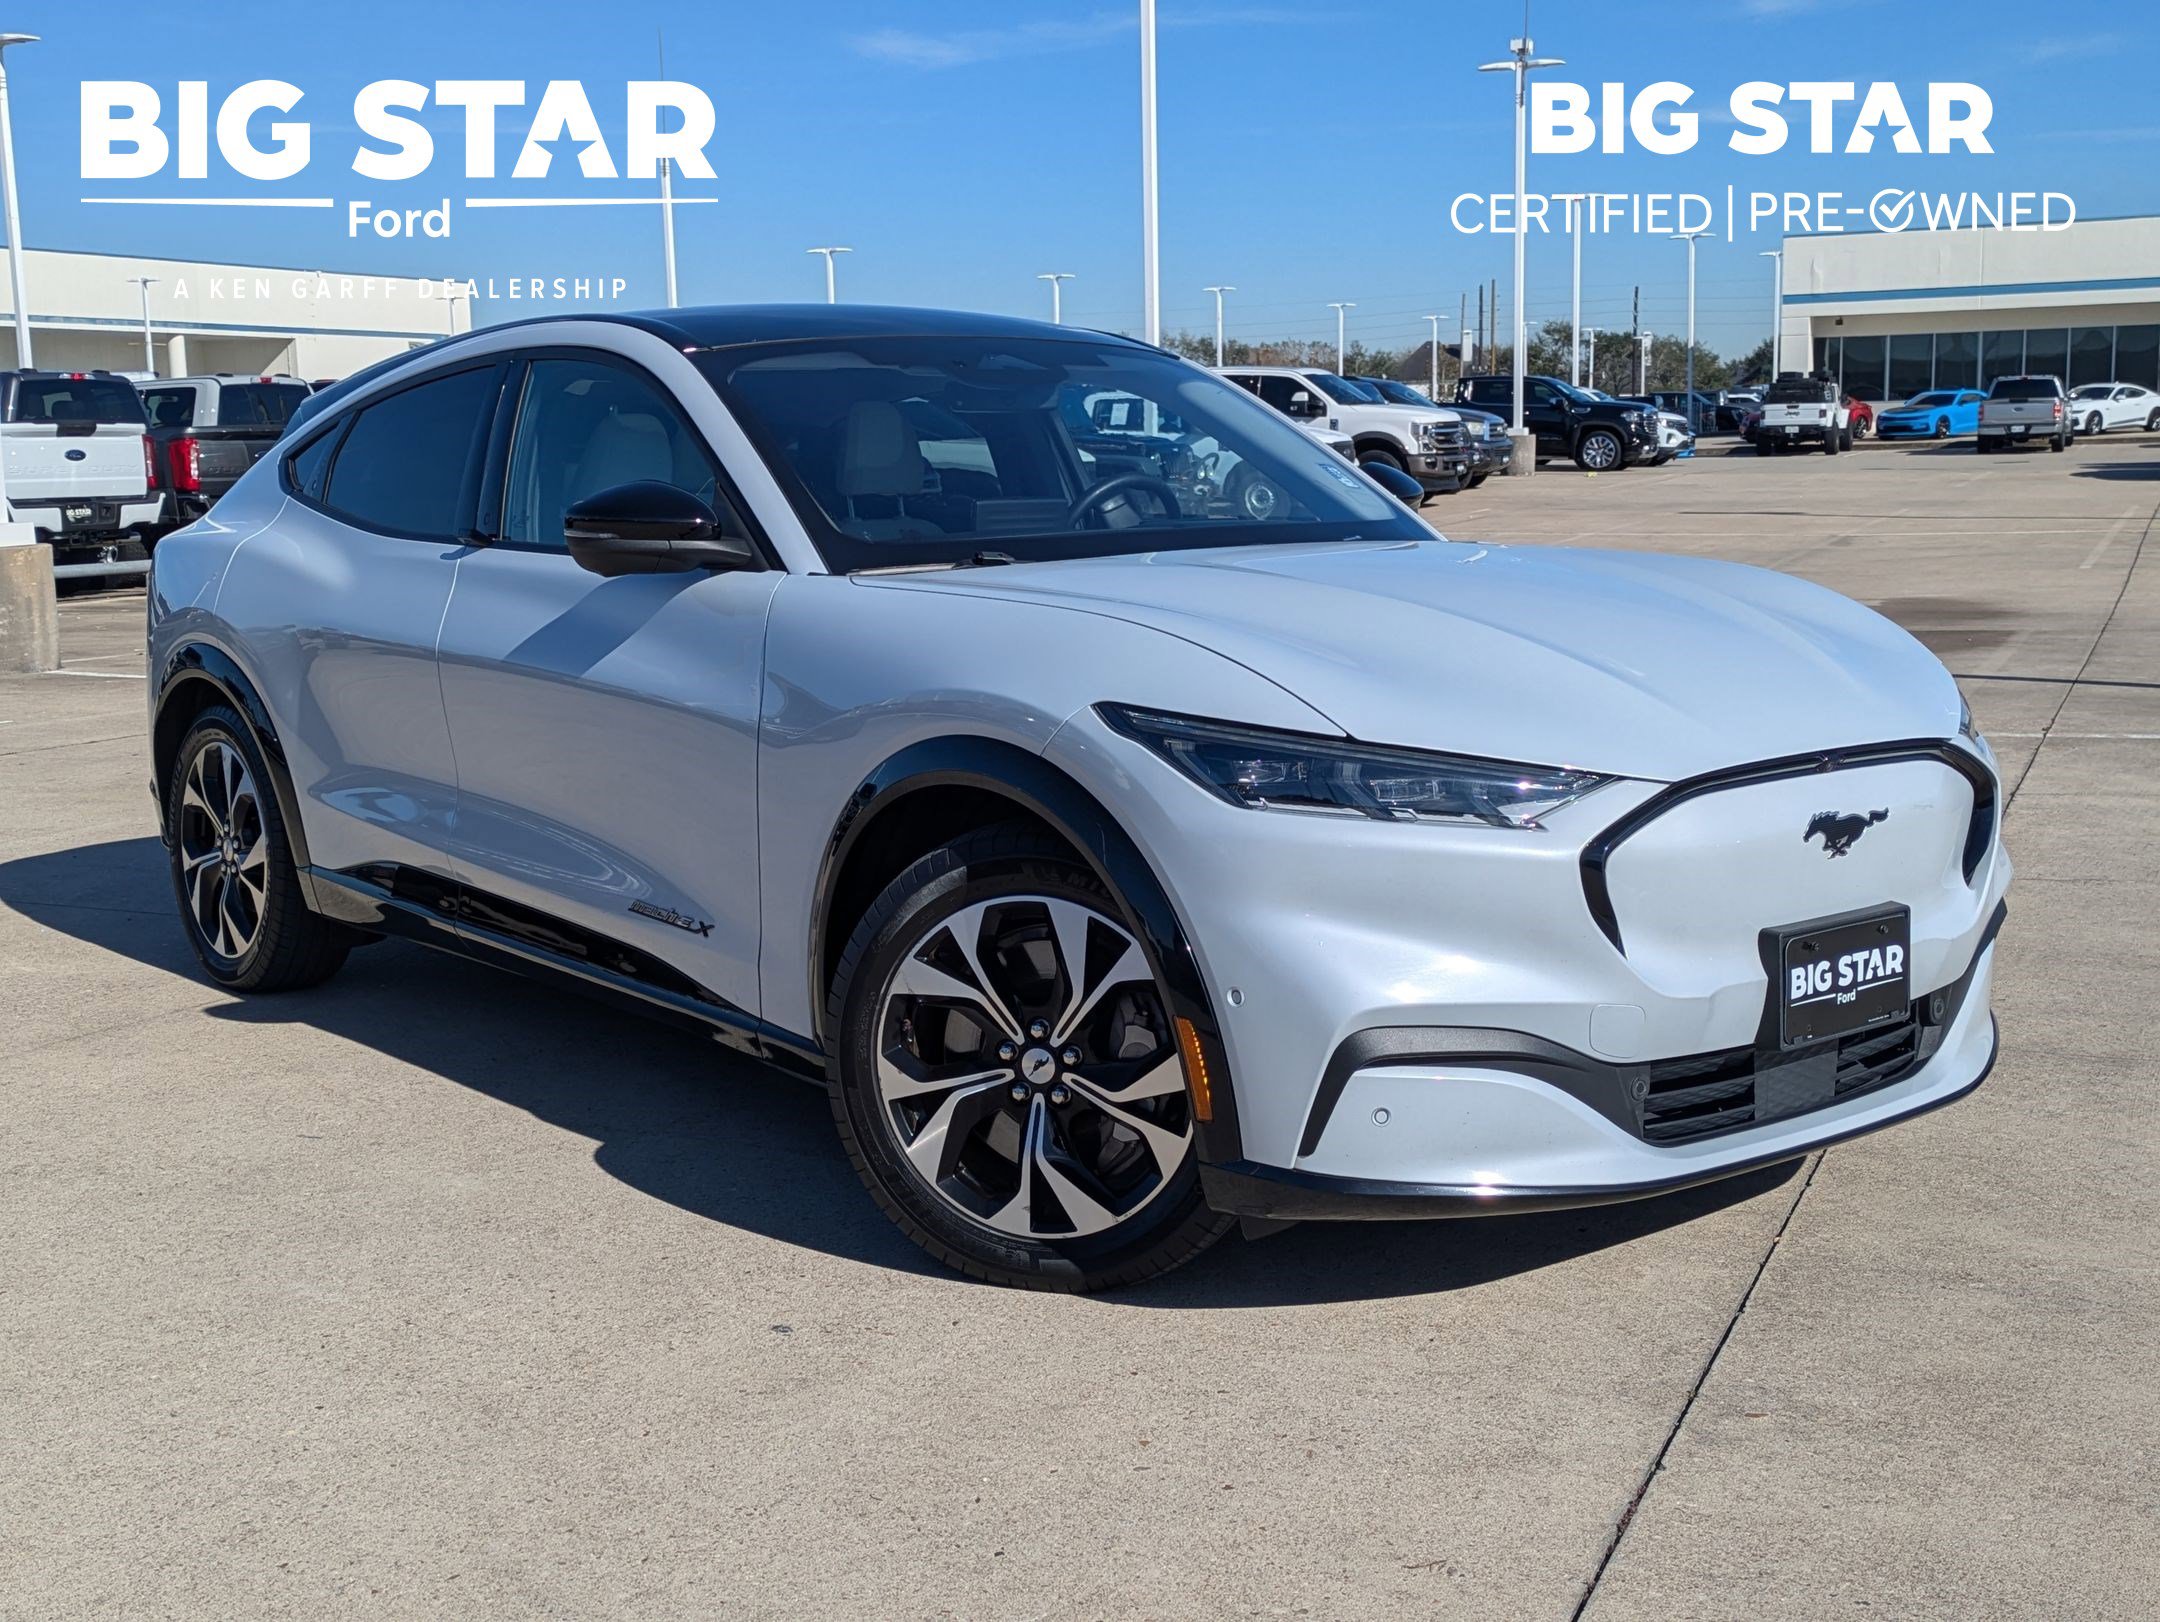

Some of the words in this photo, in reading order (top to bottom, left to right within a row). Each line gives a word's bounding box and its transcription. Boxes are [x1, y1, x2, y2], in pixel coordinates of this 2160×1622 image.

[1790, 960, 1833, 1001] BIG
[1838, 944, 1904, 987] STAR
[1837, 988, 1856, 1005] Ford
